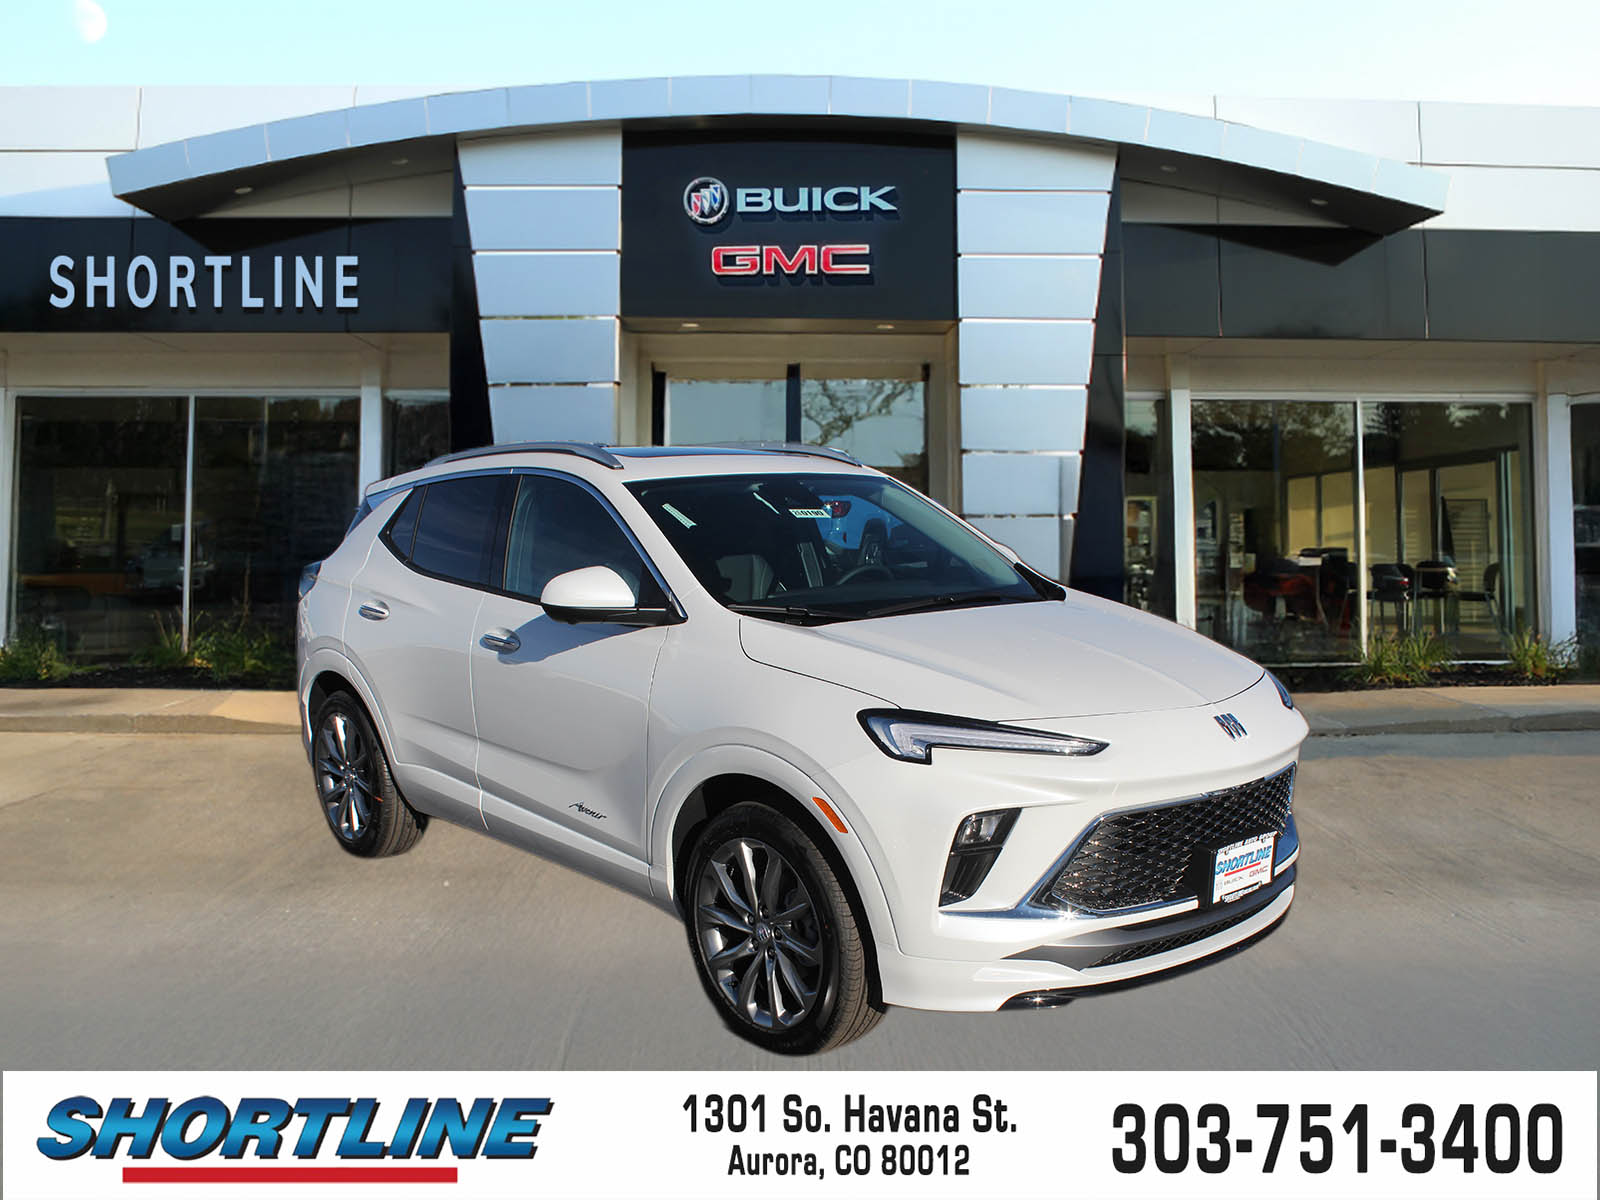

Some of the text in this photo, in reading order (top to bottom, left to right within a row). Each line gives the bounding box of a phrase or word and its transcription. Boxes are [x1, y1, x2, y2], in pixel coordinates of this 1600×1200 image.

[736, 186, 898, 212] BUICK
[711, 244, 870, 275] GMC
[49, 255, 359, 309] SHORTLINE
[1215, 845, 1272, 875] SHORTLINE
